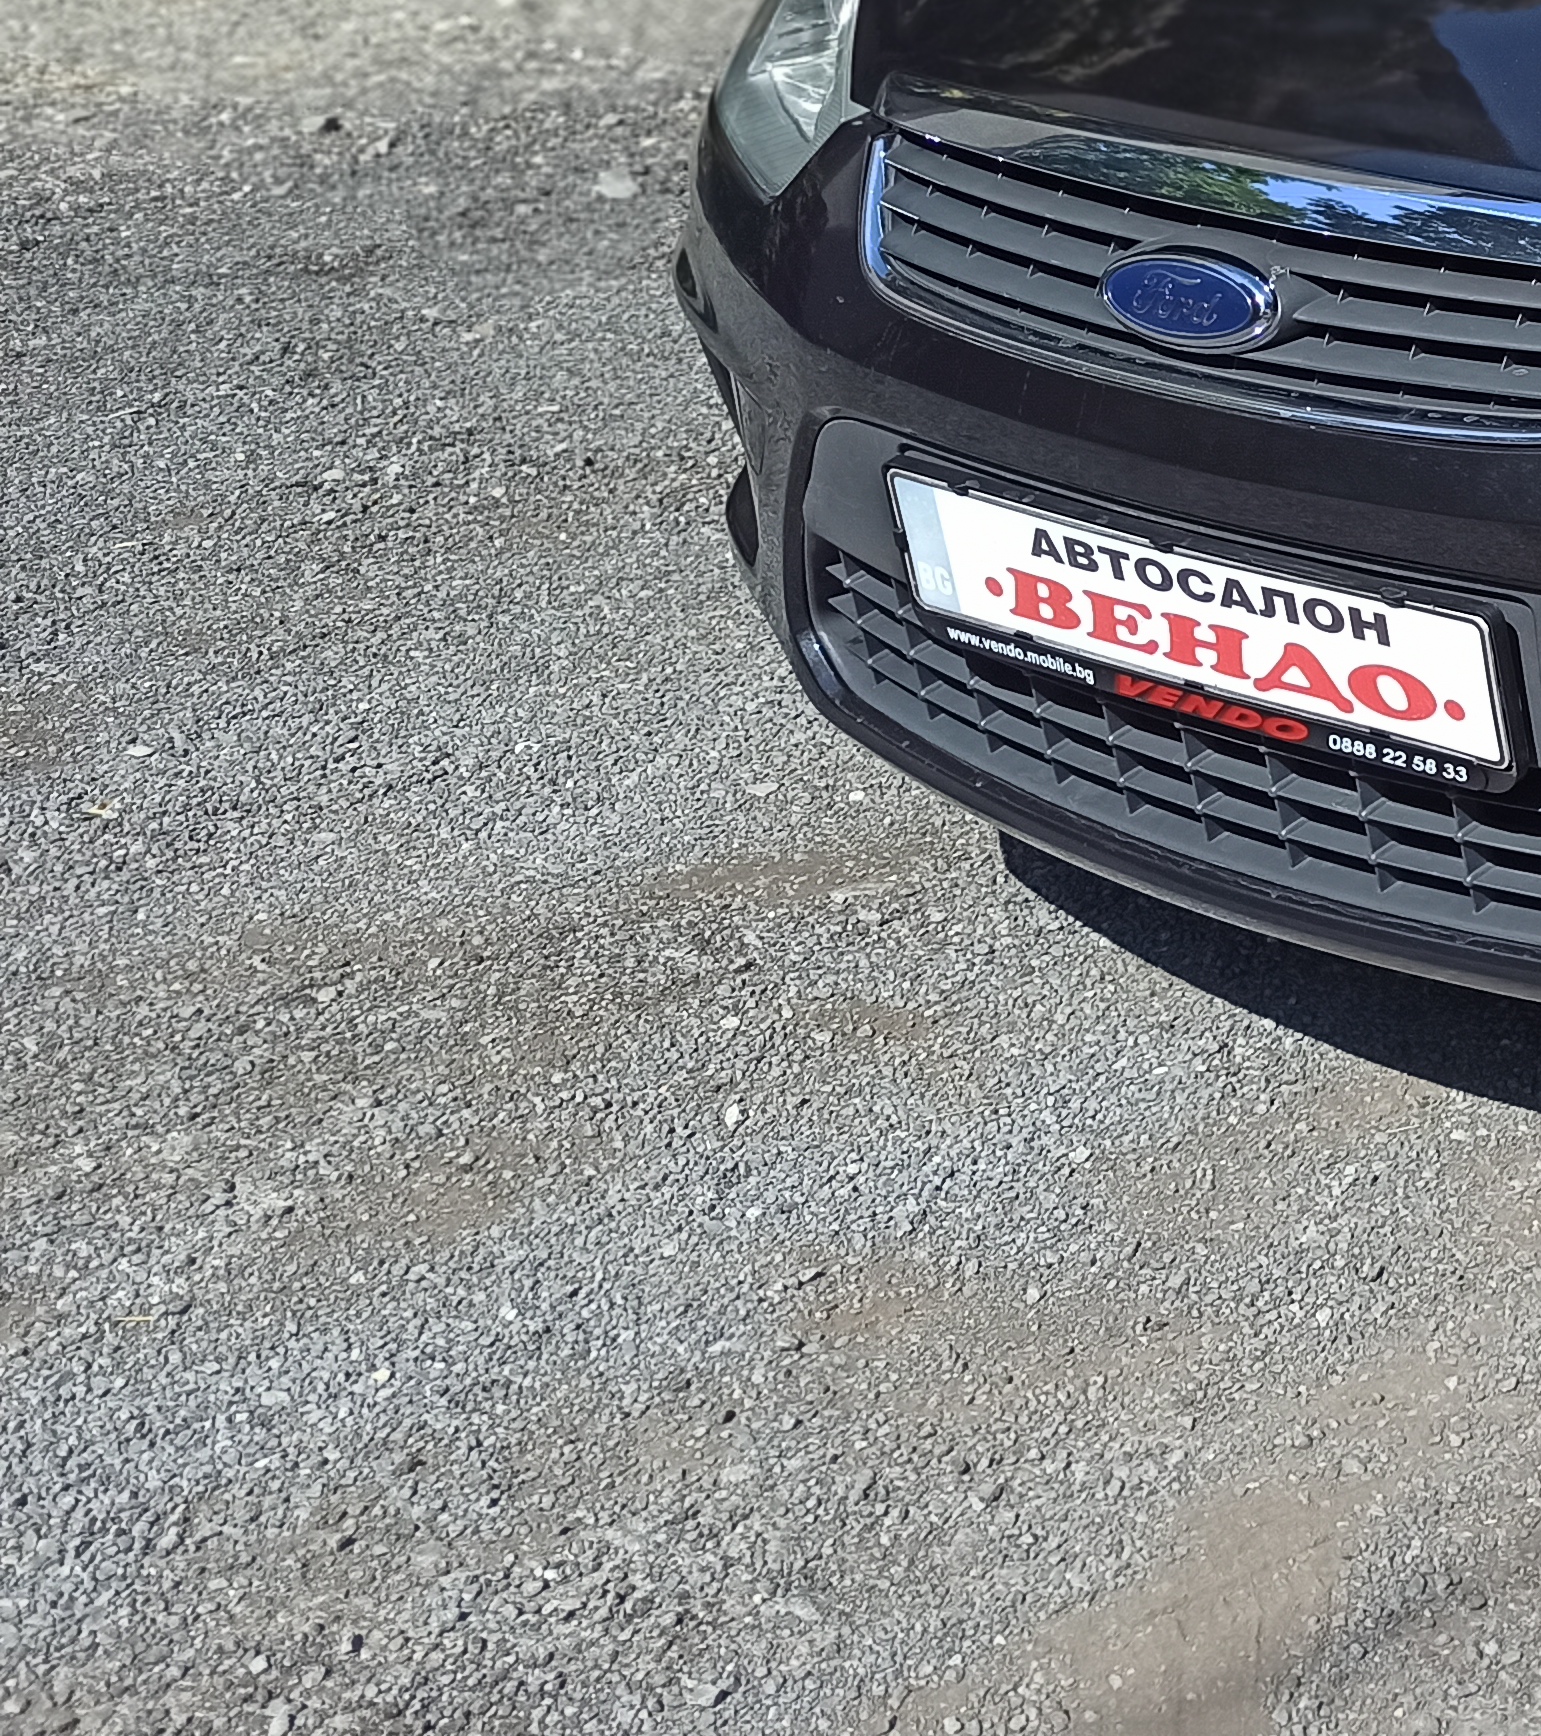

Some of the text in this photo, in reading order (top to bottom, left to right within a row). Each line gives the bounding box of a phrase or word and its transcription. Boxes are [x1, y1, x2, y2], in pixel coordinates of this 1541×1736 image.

[1133, 269, 1222, 326] Ford
[919, 562, 953, 596] BG
[1030, 527, 1390, 647] АВТОСАЛОН
[947, 626, 1094, 685] www.vendo.mobile.bg
[1113, 674, 1309, 742] VENDO
[1328, 733, 1469, 783] 0888 22 58 33
